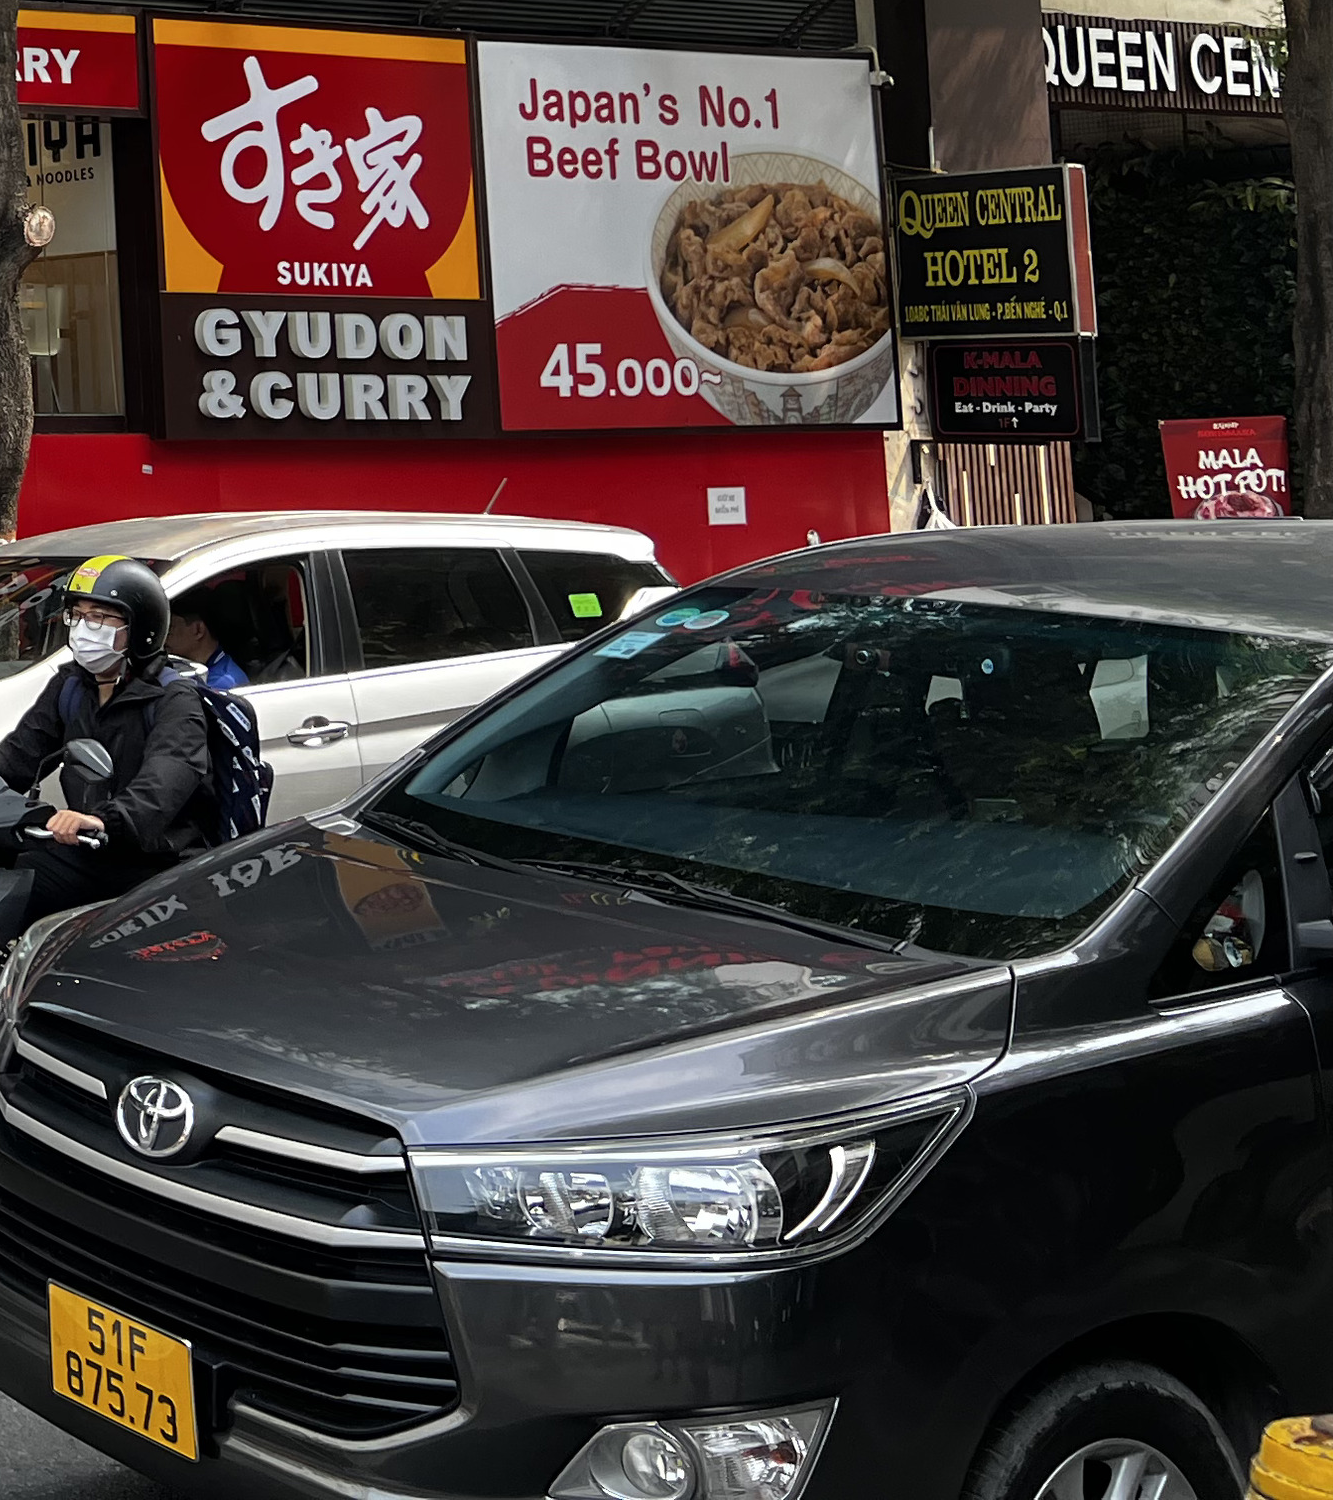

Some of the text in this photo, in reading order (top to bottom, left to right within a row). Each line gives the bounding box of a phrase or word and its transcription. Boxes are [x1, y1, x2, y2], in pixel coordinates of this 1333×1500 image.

[700, 85, 780, 130] No.1
[201, 55, 430, 250] すき家
[526, 136, 732, 184] Beef Bowl
[36, 166, 95, 186] NOODLES
[899, 184, 1062, 238] QUEEN CENTRAL
[276, 260, 373, 288] SUKIYA
[923, 248, 1039, 286] HOTEL 2
[930, 300, 950, 321] THÁI
[969, 304, 991, 321] LUNG
[1054, 299, 1069, 320] Q.1
[194, 307, 469, 362] GYUDON
[963, 350, 1042, 369] K-MALA
[198, 370, 471, 422] &CURRY
[952, 375, 1057, 397] DINNING
[954, 402, 974, 413] Eat
[982, 401, 1015, 414] Drink
[1024, 402, 1058, 416] Party
[1198, 447, 1264, 470] MALA
[1176, 473, 1233, 499] HOT
[85, 1309, 147, 1370] 51F
[64, 1348, 180, 1446] 875.73
